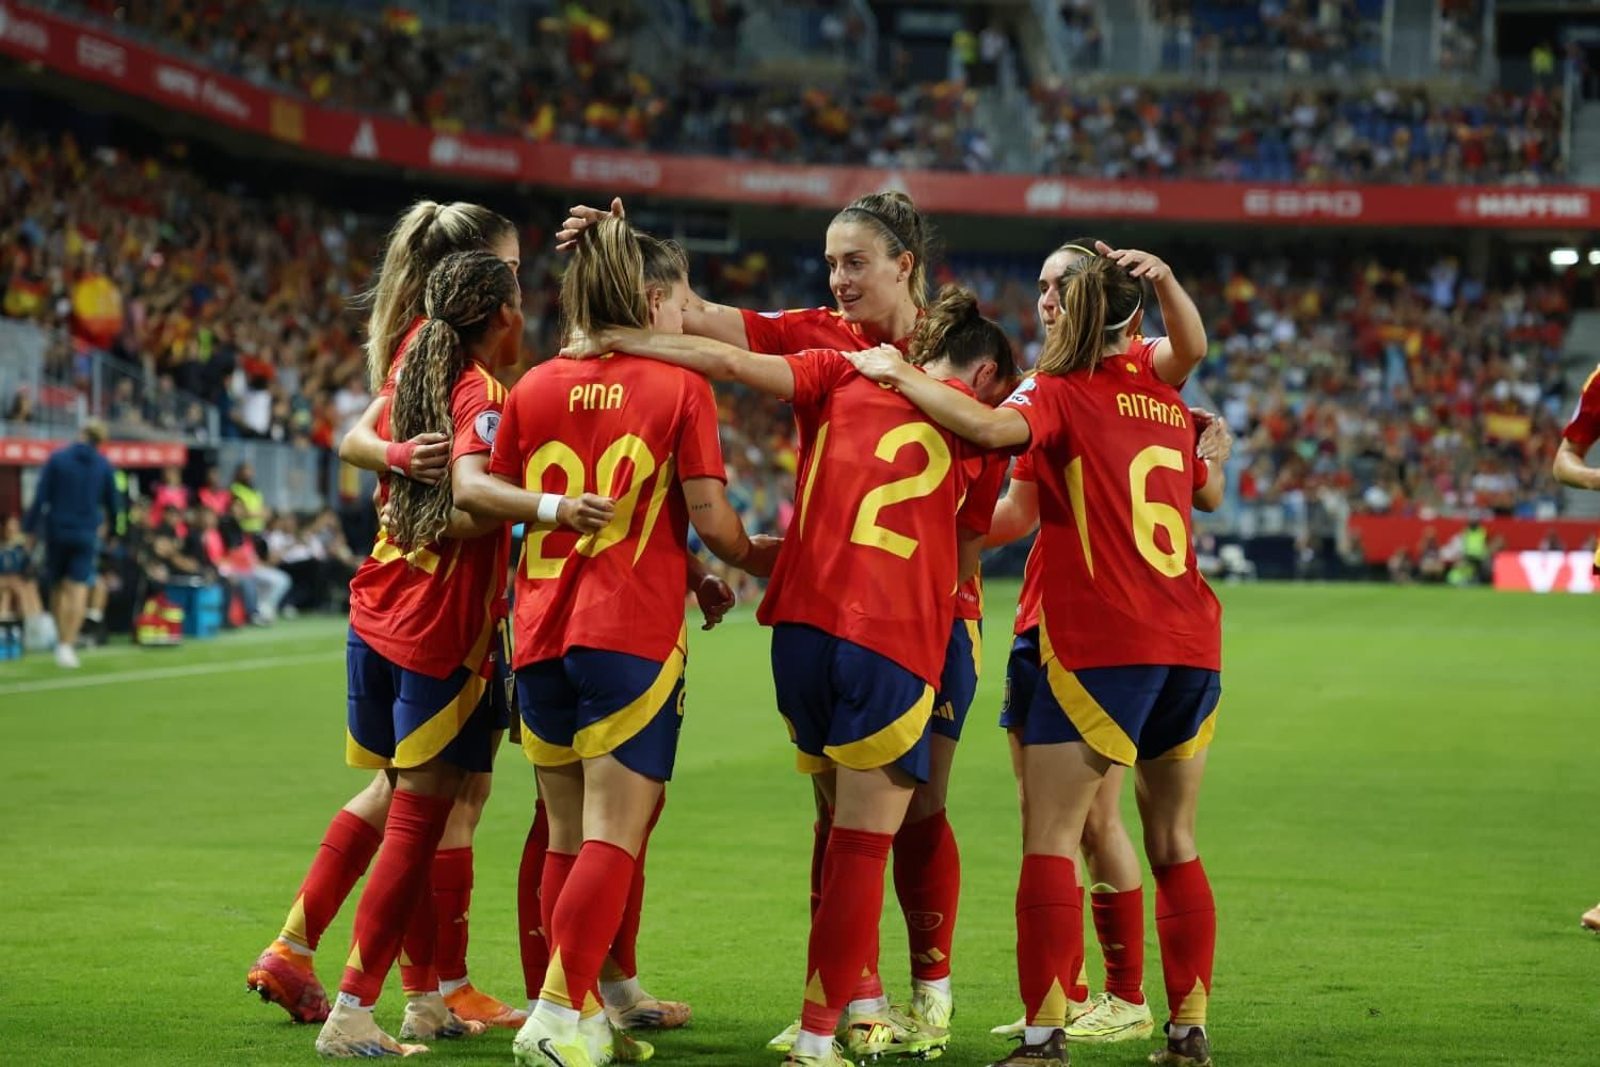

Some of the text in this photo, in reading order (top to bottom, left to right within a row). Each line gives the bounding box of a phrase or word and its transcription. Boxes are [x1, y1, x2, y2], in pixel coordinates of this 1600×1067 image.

[569, 384, 623, 412] PINA
[1117, 393, 1186, 428] AITANA
[851, 422, 951, 559] 2
[1130, 445, 1187, 577] 6
